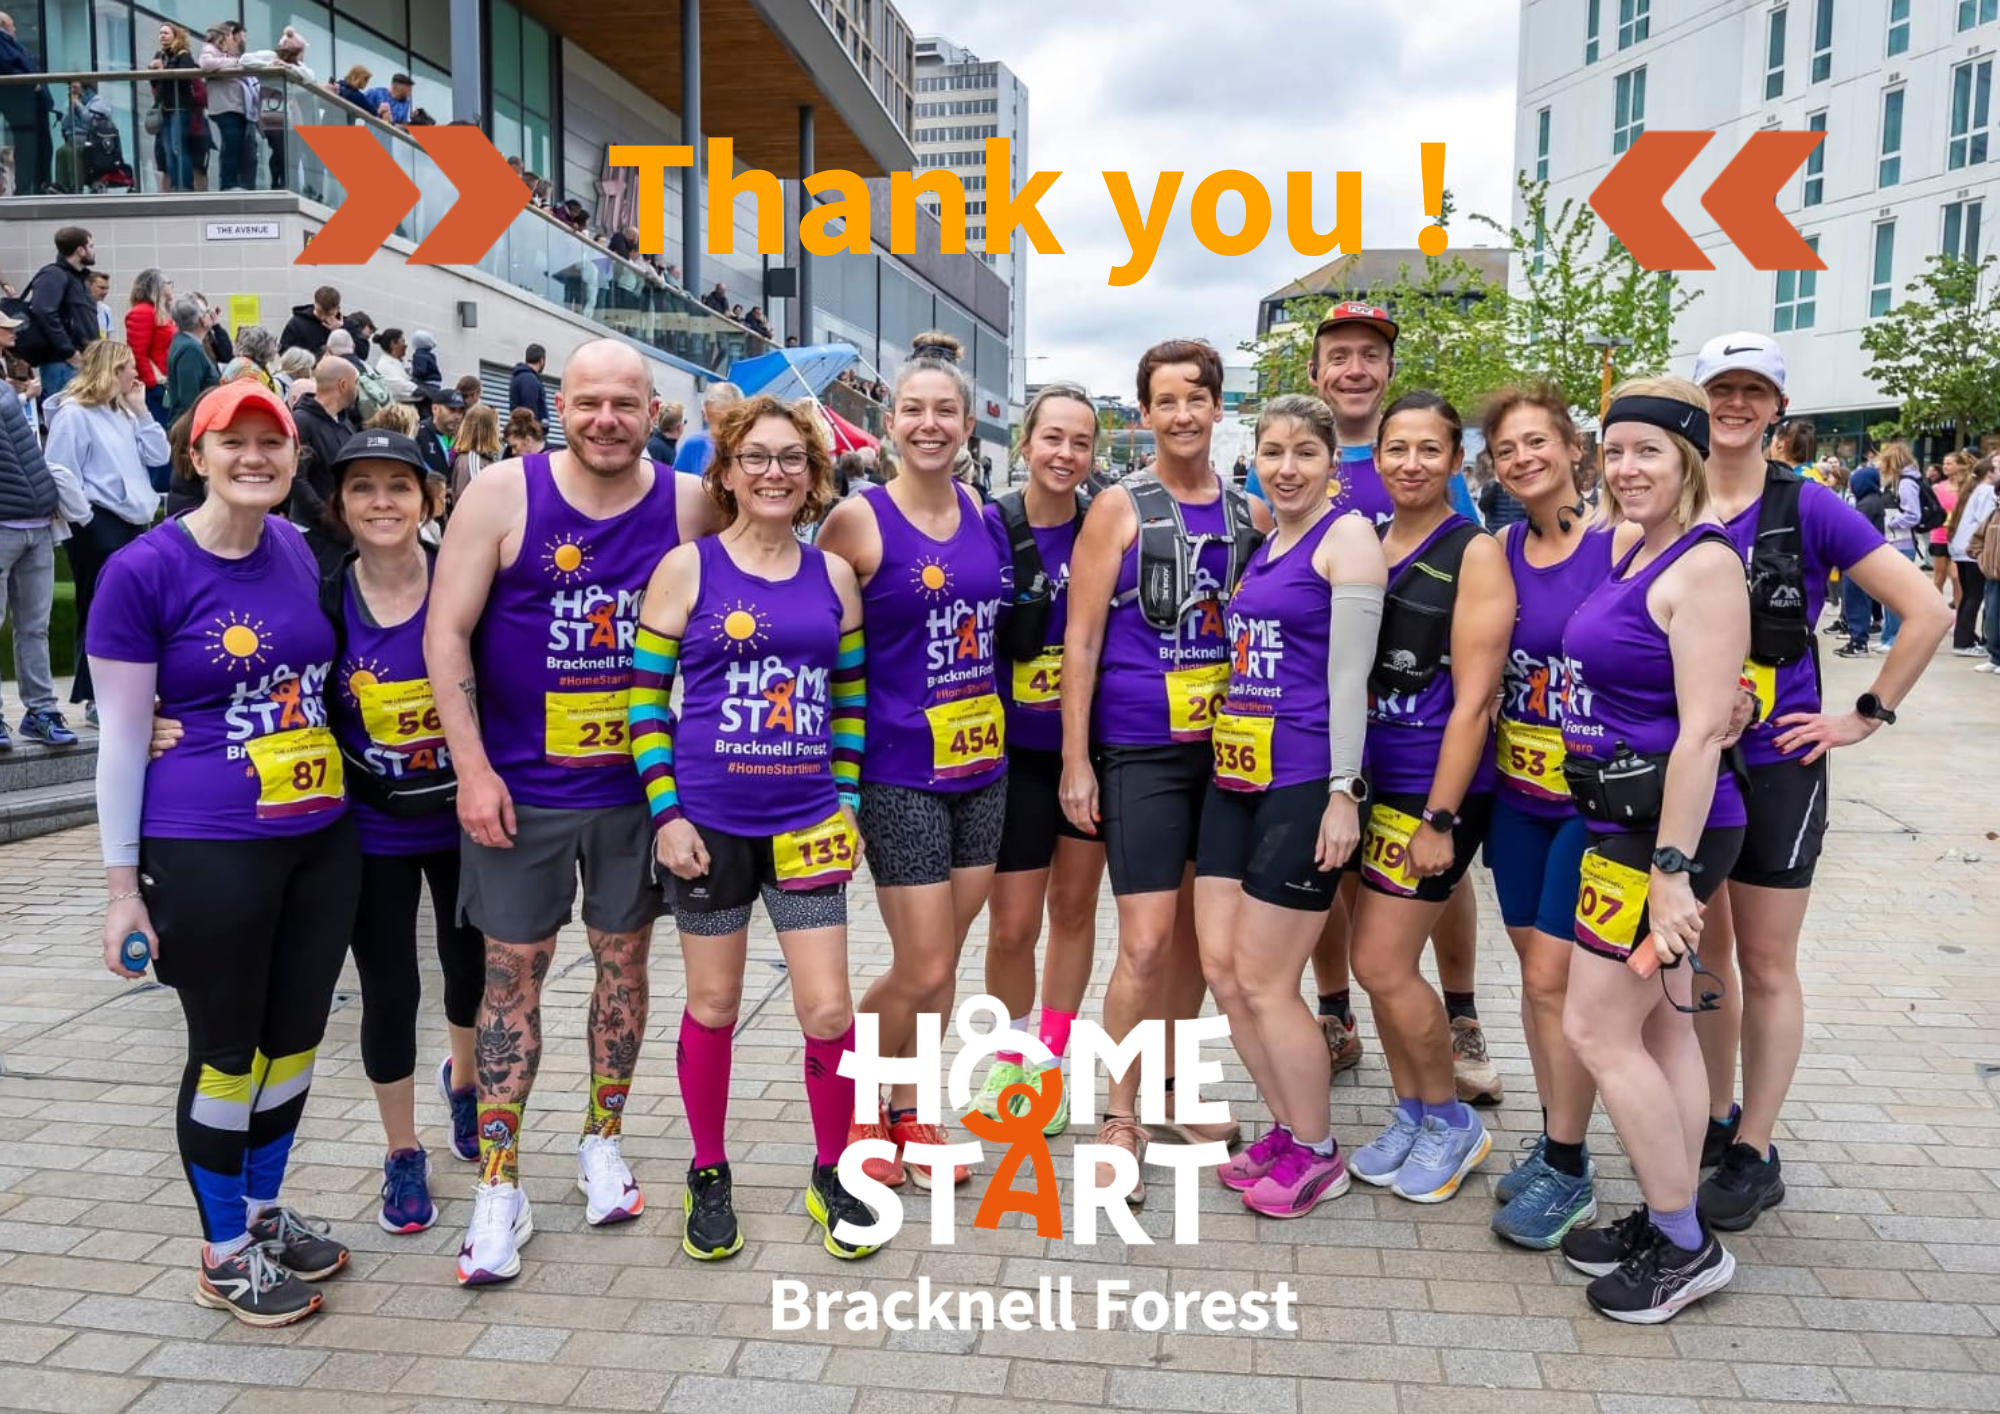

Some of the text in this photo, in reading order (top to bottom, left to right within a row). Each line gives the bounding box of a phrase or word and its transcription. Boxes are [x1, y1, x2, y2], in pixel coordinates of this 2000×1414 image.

[217, 226, 269, 235] THE AVENUE
[550, 585, 645, 619] HOM
[548, 619, 639, 652] STAR
[1228, 612, 1284, 648] OME
[546, 655, 615, 669] Bracknell
[229, 661, 333, 706] HOM
[1245, 683, 1282, 698] Forest
[397, 706, 442, 736] 56
[718, 697, 825, 736] START
[1566, 720, 1605, 737] Forest
[578, 720, 625, 748] 23
[714, 738, 827, 756] Bracknell Forest
[950, 722, 999, 756] 454
[292, 757, 327, 791] 87
[1511, 744, 1547, 777] 53
[798, 832, 852, 867] 133
[1580, 885, 1624, 925] 07
